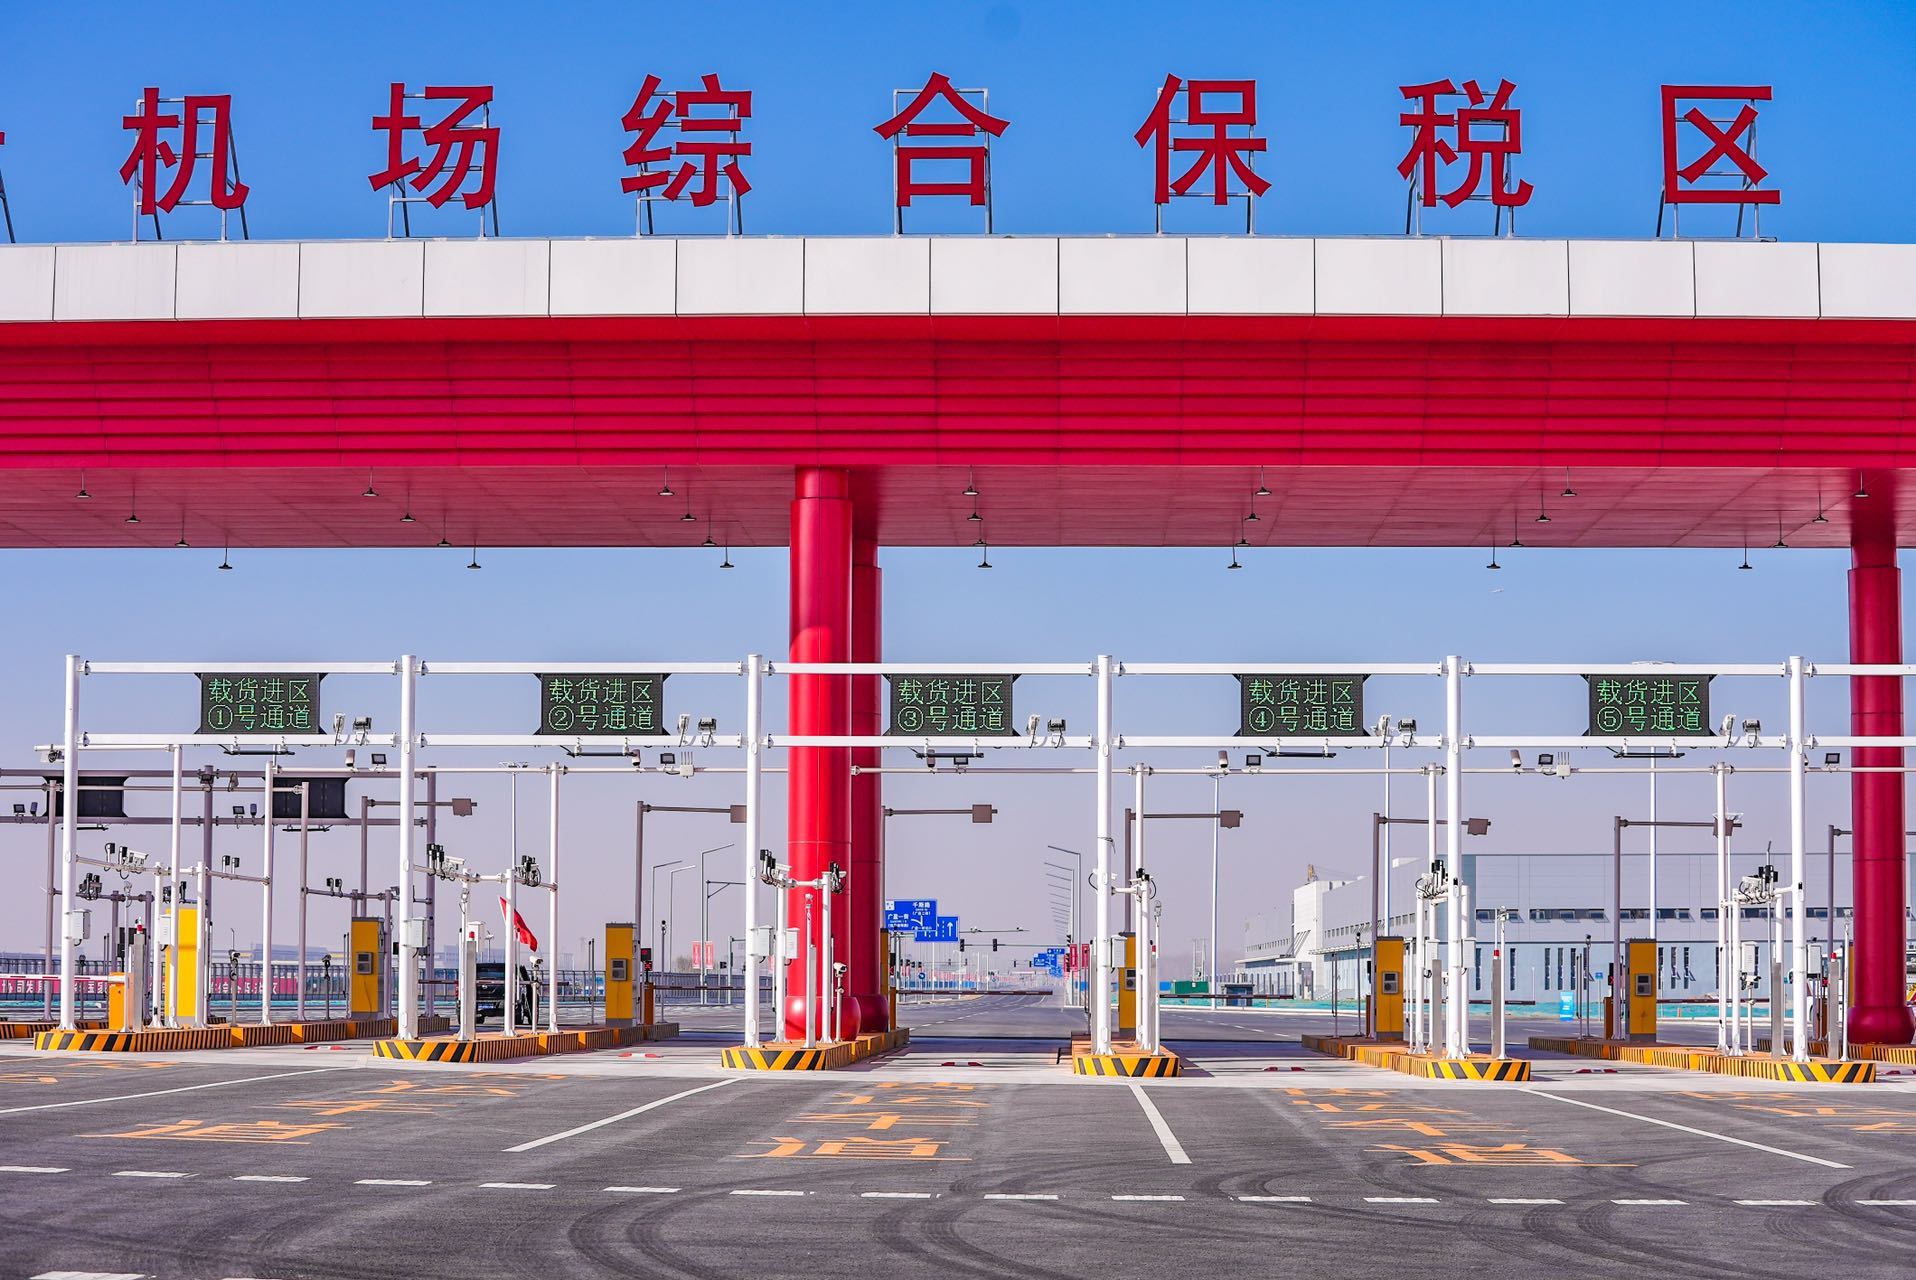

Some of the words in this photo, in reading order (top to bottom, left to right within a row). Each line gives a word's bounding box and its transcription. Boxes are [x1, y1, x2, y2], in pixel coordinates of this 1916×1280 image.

[0, 73, 1781, 215] 机场综合保税区
[208, 678, 310, 703] 载货进区
[549, 678, 654, 704] 载货进区
[898, 679, 1004, 705] 载货进区
[1248, 679, 1355, 705] 载货进区
[1597, 679, 1701, 705] 载货进区
